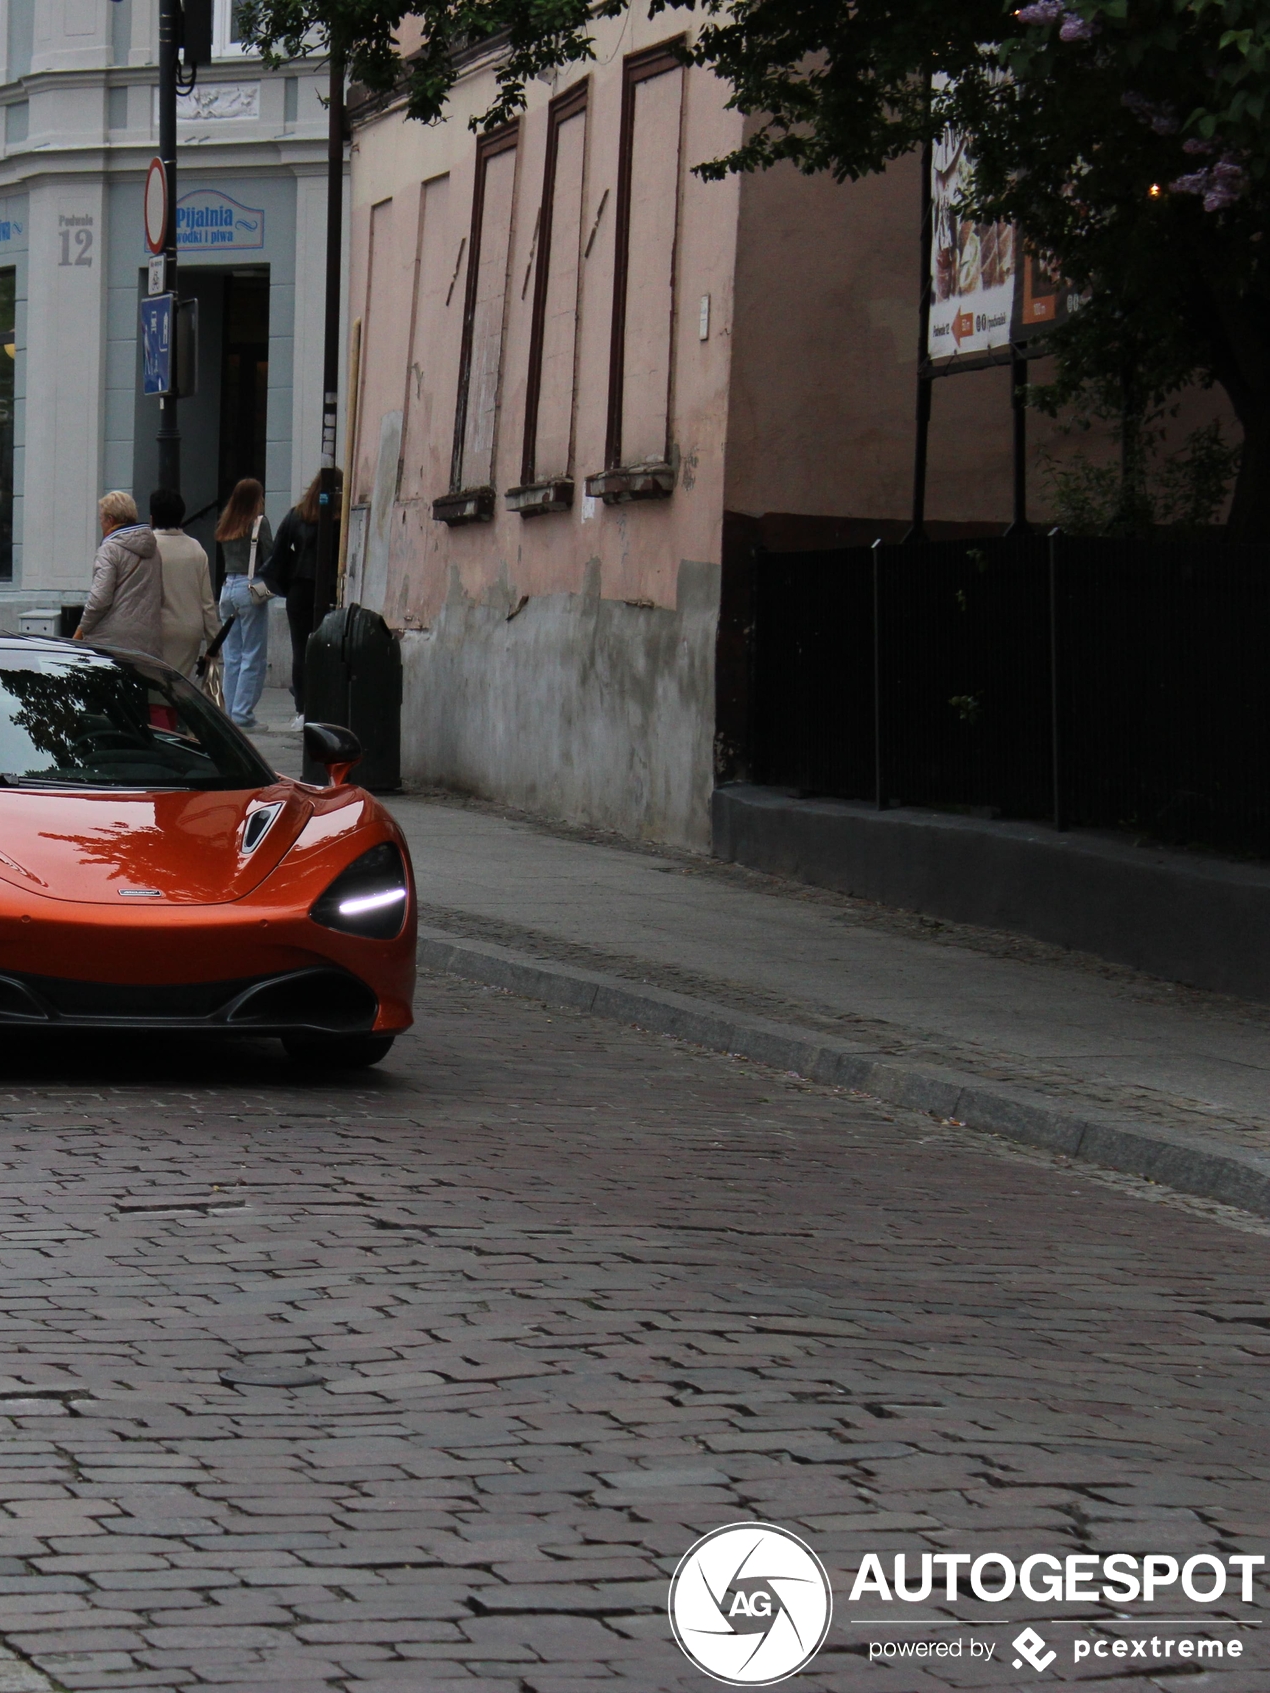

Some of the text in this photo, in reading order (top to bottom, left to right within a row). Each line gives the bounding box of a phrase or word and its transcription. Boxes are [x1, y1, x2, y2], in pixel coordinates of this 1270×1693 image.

[58, 213, 94, 227] Podwale
[176, 205, 233, 230] Pijalnia
[211, 229, 234, 244] piwa
[58, 228, 93, 268] 12
